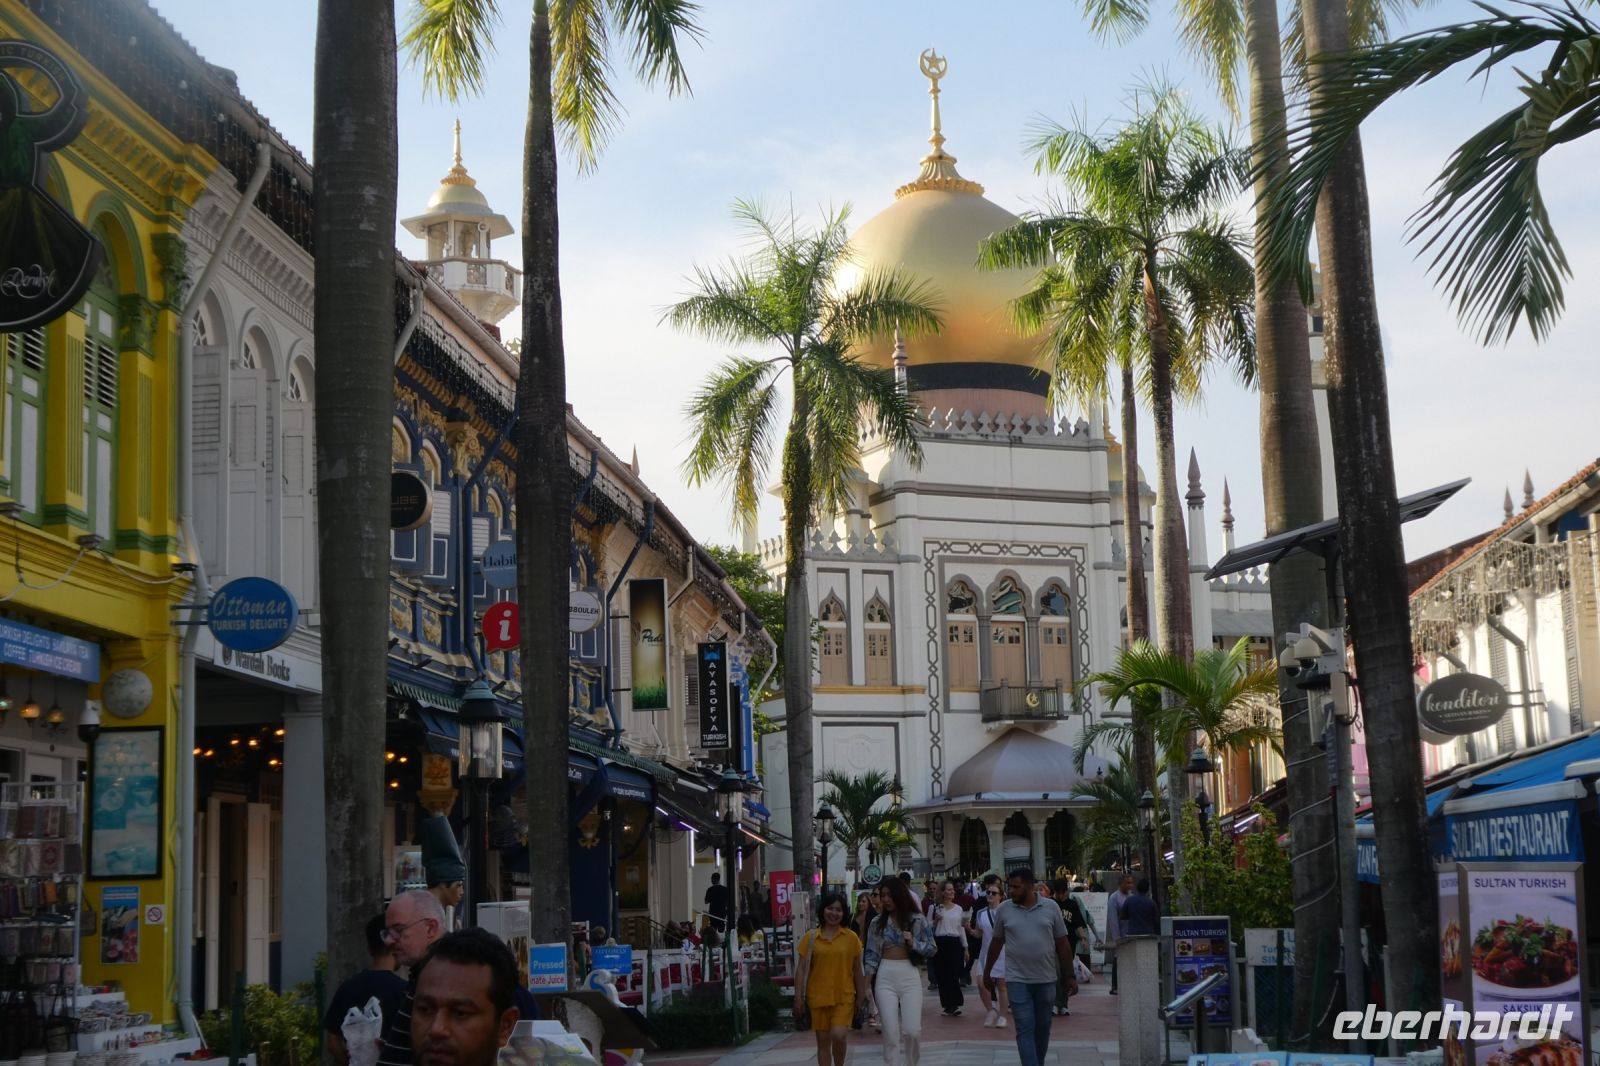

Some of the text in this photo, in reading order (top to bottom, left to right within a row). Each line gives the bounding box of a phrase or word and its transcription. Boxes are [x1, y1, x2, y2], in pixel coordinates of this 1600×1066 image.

[212, 592, 287, 616] Ottoman
[211, 618, 288, 631] TURKISH DELIGHTS
[266, 655, 291, 681] Books
[708, 662, 719, 732] AYASOFYA
[1425, 688, 1500, 712] konditori
[1451, 810, 1569, 858] SULTAN RESTAURANT
[1474, 877, 1567, 889] SULTAN TURKISH
[1175, 929, 1228, 937] SULTAN TURKISH
[533, 960, 564, 969] Pressed
